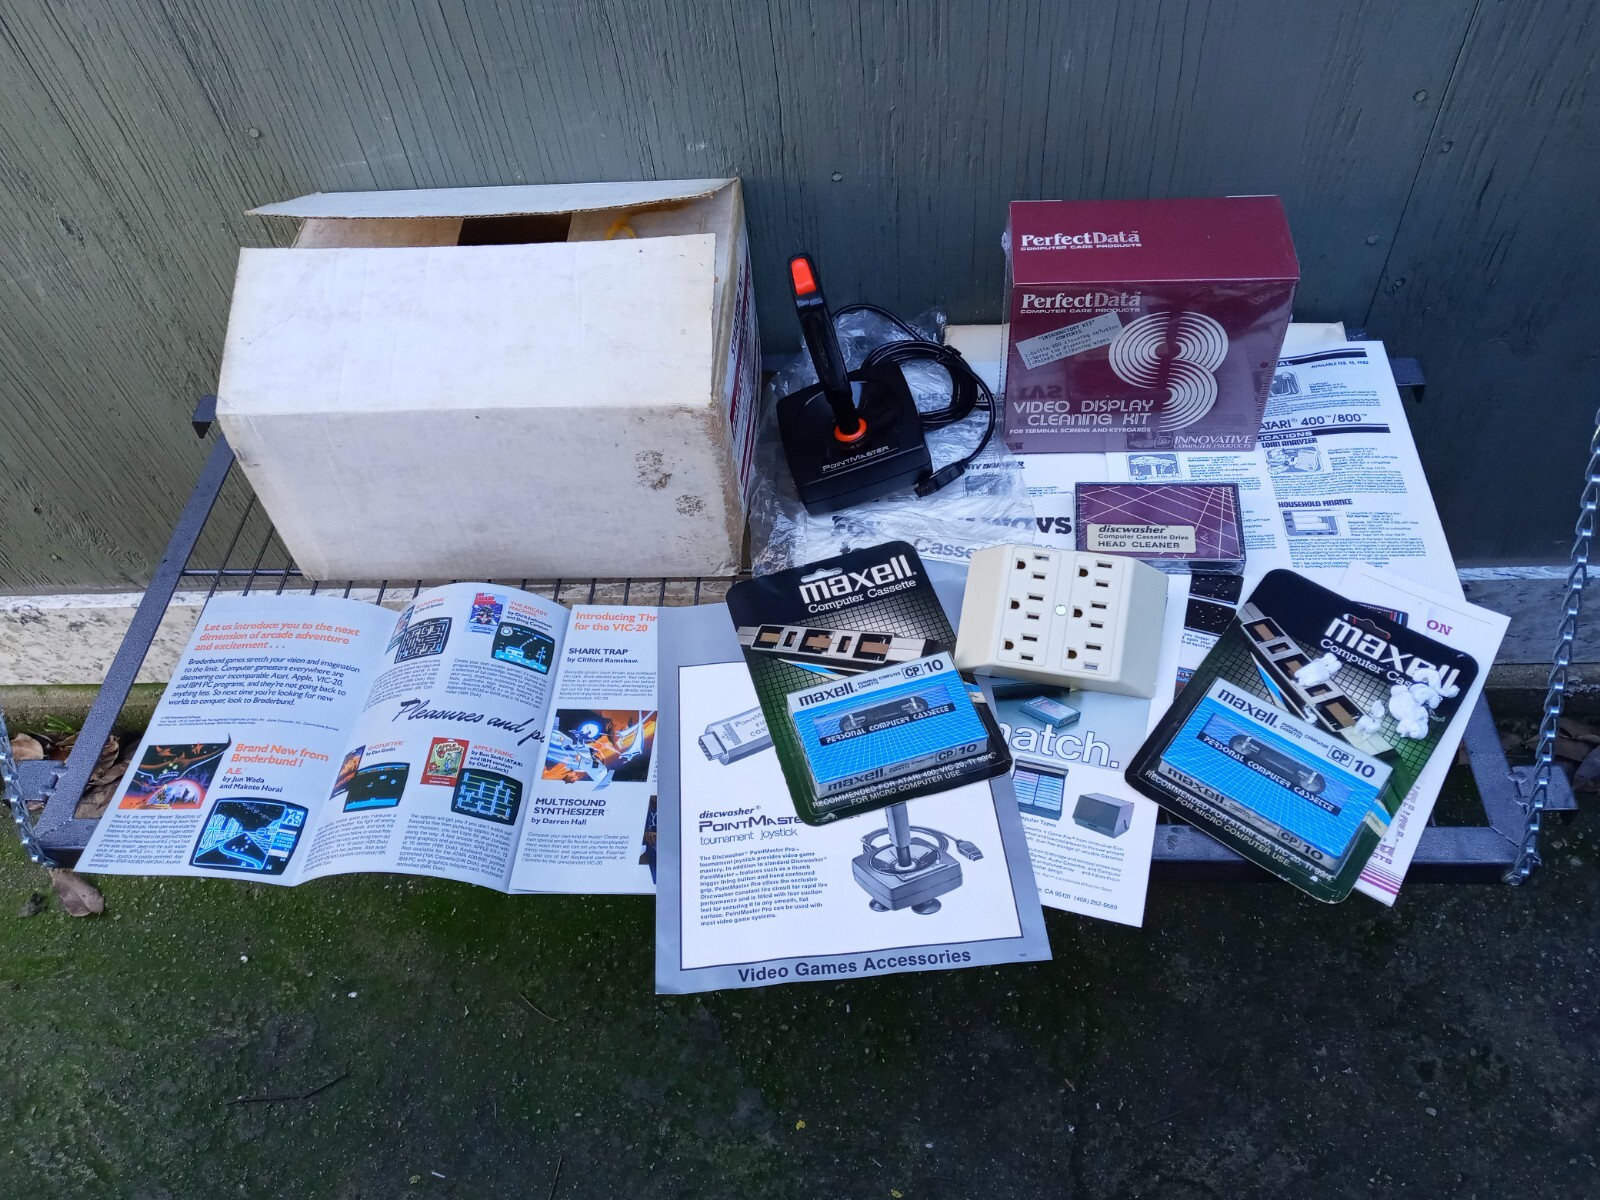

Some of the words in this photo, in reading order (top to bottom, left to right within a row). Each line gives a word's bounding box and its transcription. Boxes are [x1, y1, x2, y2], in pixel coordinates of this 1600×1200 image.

[1021, 231, 1140, 246] PerfectData
[1022, 292, 1140, 308] PerfectData
[1013, 401, 1070, 413] VIDEO
[1081, 400, 1154, 412] DISPLAY
[1028, 414, 1112, 426] CLEANING
[1123, 413, 1151, 425] KIT
[1174, 435, 1254, 444] INNOVATIVE
[1257, 430, 1313, 441] ICATIONS
[1282, 437, 1317, 446] ANALYZER
[822, 446, 889, 471] POINTMASTER
[1098, 525, 1166, 534] discwasher
[913, 537, 977, 560] Casse
[799, 555, 912, 604] maxell
[808, 594, 864, 613] Computer
[867, 580, 916, 598] Cassette
[576, 612, 636, 623] Introducing
[638, 613, 658, 622] Thr
[234, 622, 279, 630] introduce
[315, 622, 332, 632] the
[335, 626, 360, 636] next
[575, 622, 590, 631] for
[592, 623, 609, 631] the
[613, 624, 648, 632] VIC-20
[194, 643, 213, 651] and
[214, 641, 268, 650] excitement
[200, 633, 247, 641] dimension
[296, 632, 350, 644] adventure
[1320, 638, 1384, 674] Computer
[289, 666, 331, 675] everywhere
[321, 659, 360, 673] imagination
[799, 682, 855, 706] maxell
[905, 666, 920, 677] CP
[924, 659, 944, 673] 10
[392, 698, 484, 723] Pleasures
[487, 717, 535, 734] and
[826, 728, 866, 744] PERSONAL
[869, 717, 910, 732] COMPUTER
[913, 706, 949, 720] CASSETTE
[1218, 689, 1278, 726] maxell
[1332, 750, 1350, 762] CP
[1355, 760, 1376, 778] 10
[235, 743, 269, 753] Brand
[270, 744, 298, 756] New
[300, 748, 329, 762] from
[1000, 722, 1120, 769] atch.
[828, 768, 884, 791] maxell
[959, 744, 977, 755] 10
[1204, 736, 1244, 762] PERSONAL
[1248, 760, 1292, 788] COMPUTER
[1294, 787, 1335, 812] CASSETTE
[812, 786, 877, 808] RECOMMENDED
[878, 780, 896, 792] FOR
[851, 795, 868, 805] FOR
[870, 788, 896, 801] MICRO
[900, 774, 944, 792] COMPUTER
[535, 797, 606, 806] MULTISOUND
[1145, 770, 1209, 812] RECOMMENDED
[1210, 808, 1228, 822] FOR
[1228, 819, 1255, 837] ATARI
[534, 807, 605, 816] SYNTHESIZER
[699, 808, 754, 819] discwasher
[1168, 768, 1224, 803] maxell
[1303, 845, 1324, 861] 10
[699, 815, 803, 833] POINTMASTE
[1175, 796, 1193, 810] FOR
[1195, 808, 1222, 826] MICRO
[1224, 824, 1271, 855] COMPUTER
[700, 831, 754, 846] tournament
[760, 828, 798, 840] joystick
[738, 966, 789, 983] Video
[794, 959, 857, 977] Games
[863, 950, 972, 972] Accessories
